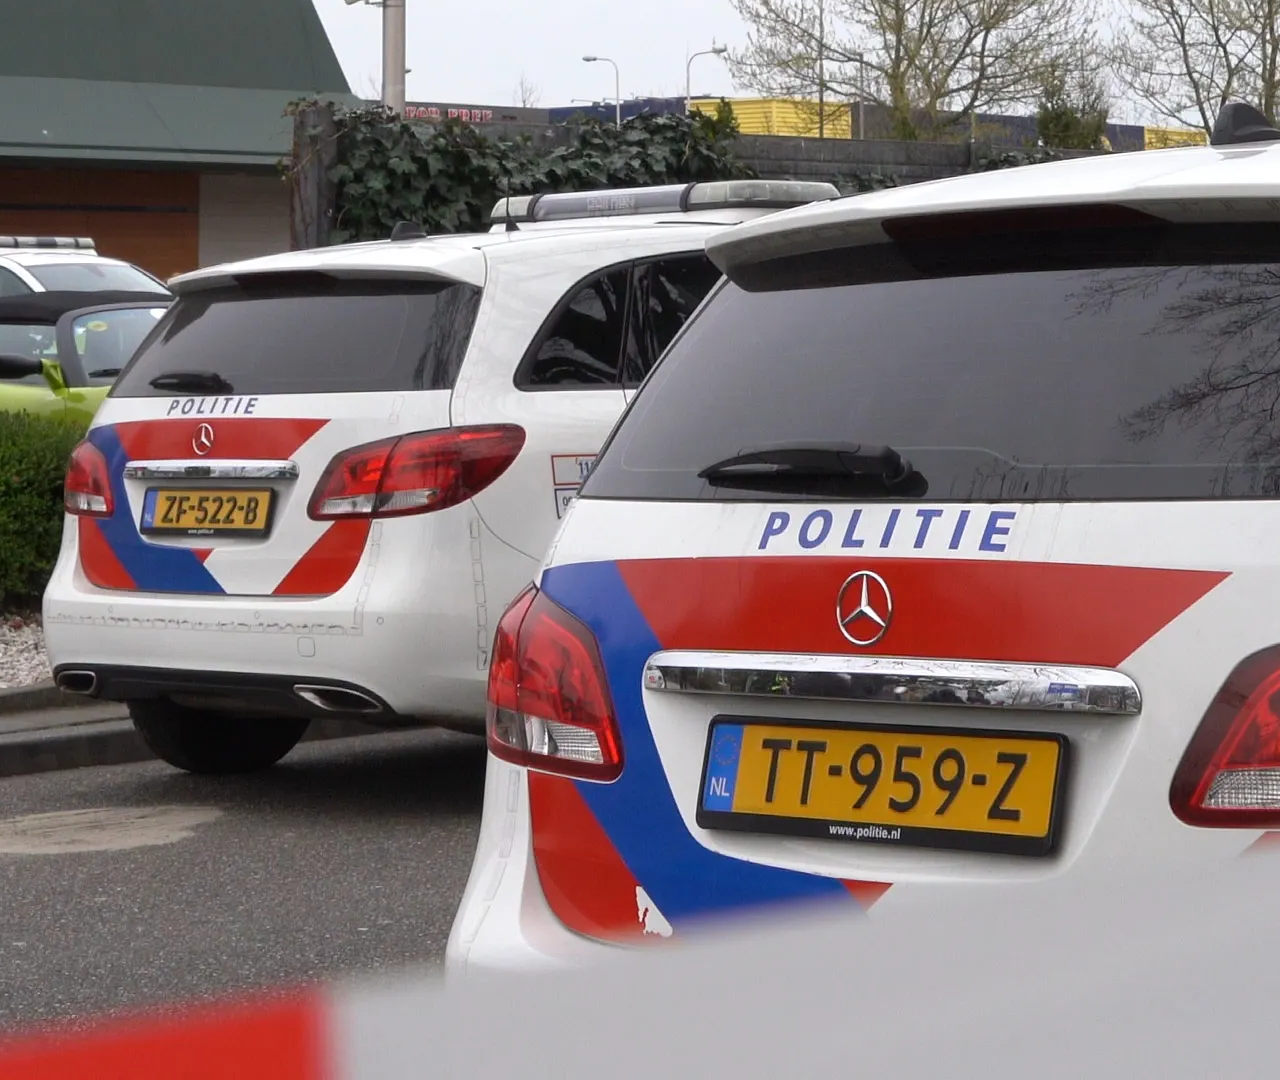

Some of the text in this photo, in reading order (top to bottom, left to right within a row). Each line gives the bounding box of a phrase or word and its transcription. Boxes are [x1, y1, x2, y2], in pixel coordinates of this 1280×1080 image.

[166, 397, 258, 416] POLITIE
[160, 495, 259, 525] ZF-522-B
[757, 508, 1017, 553] POLITIE
[709, 776, 730, 796] NL
[761, 738, 1028, 822] TT-959-Z
[829, 823, 901, 840] www.politie.nl
